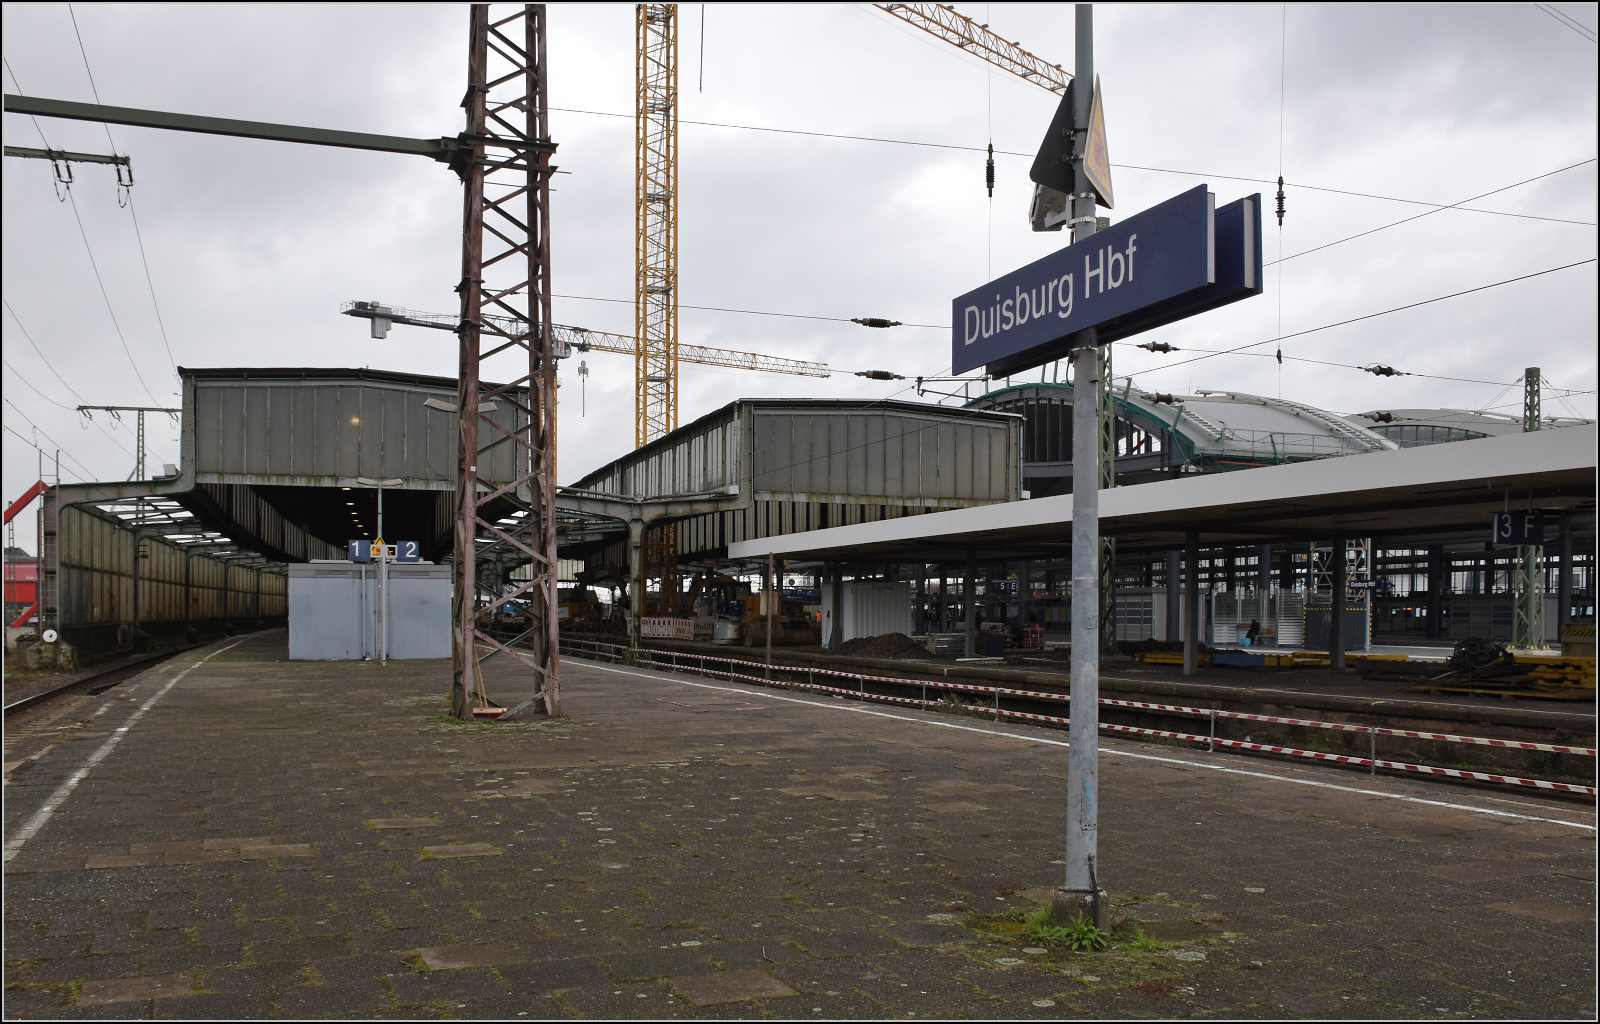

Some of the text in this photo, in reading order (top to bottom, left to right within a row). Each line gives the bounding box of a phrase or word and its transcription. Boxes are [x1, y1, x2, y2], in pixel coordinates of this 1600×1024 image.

[964, 233, 1137, 346] Duisburg Hbf
[1500, 513, 1535, 538] 3 F
[351, 540, 359, 557] 1
[405, 541, 416, 558] 2
[1000, 582, 1016, 590] 5 E
